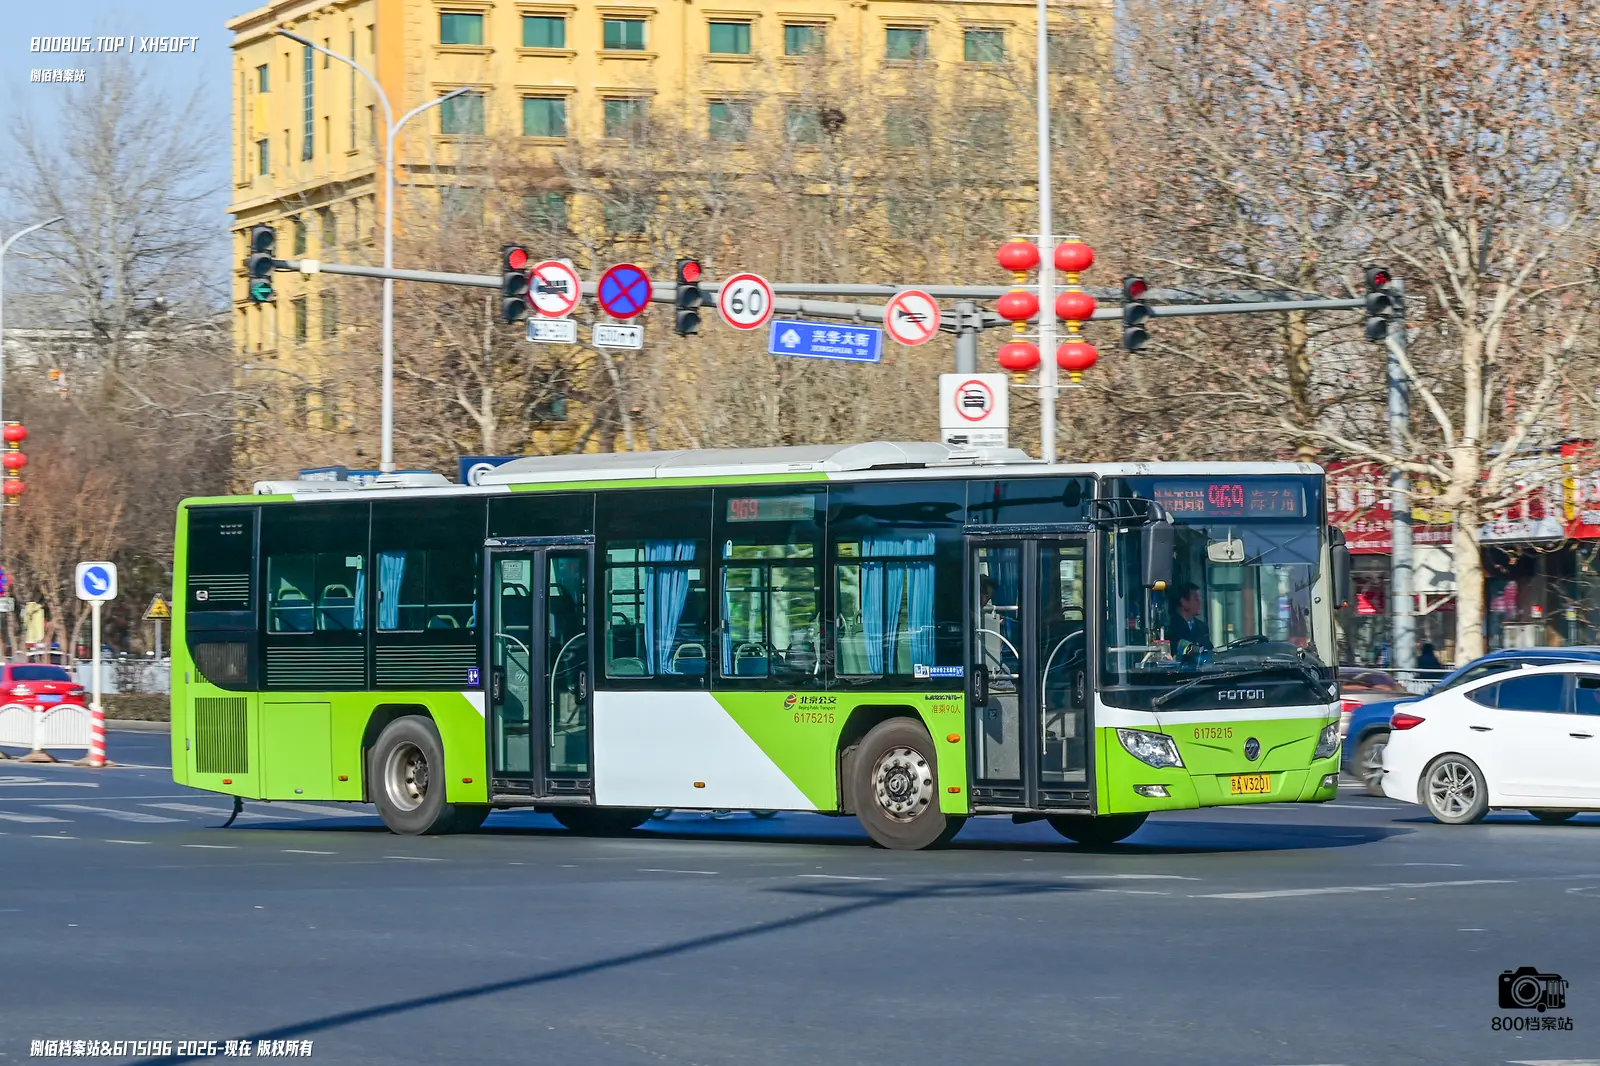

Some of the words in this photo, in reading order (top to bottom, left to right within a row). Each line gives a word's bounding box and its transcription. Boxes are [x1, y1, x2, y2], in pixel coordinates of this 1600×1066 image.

[732, 288, 762, 316] 60
[811, 329, 871, 347] 兴华大街
[1208, 484, 1245, 509] 969
[731, 499, 759, 520] 969
[800, 696, 837, 704] 北京公交
[1218, 689, 1265, 701] FOTON
[794, 712, 835, 724] 6175215
[1193, 727, 1233, 740] 6175215
